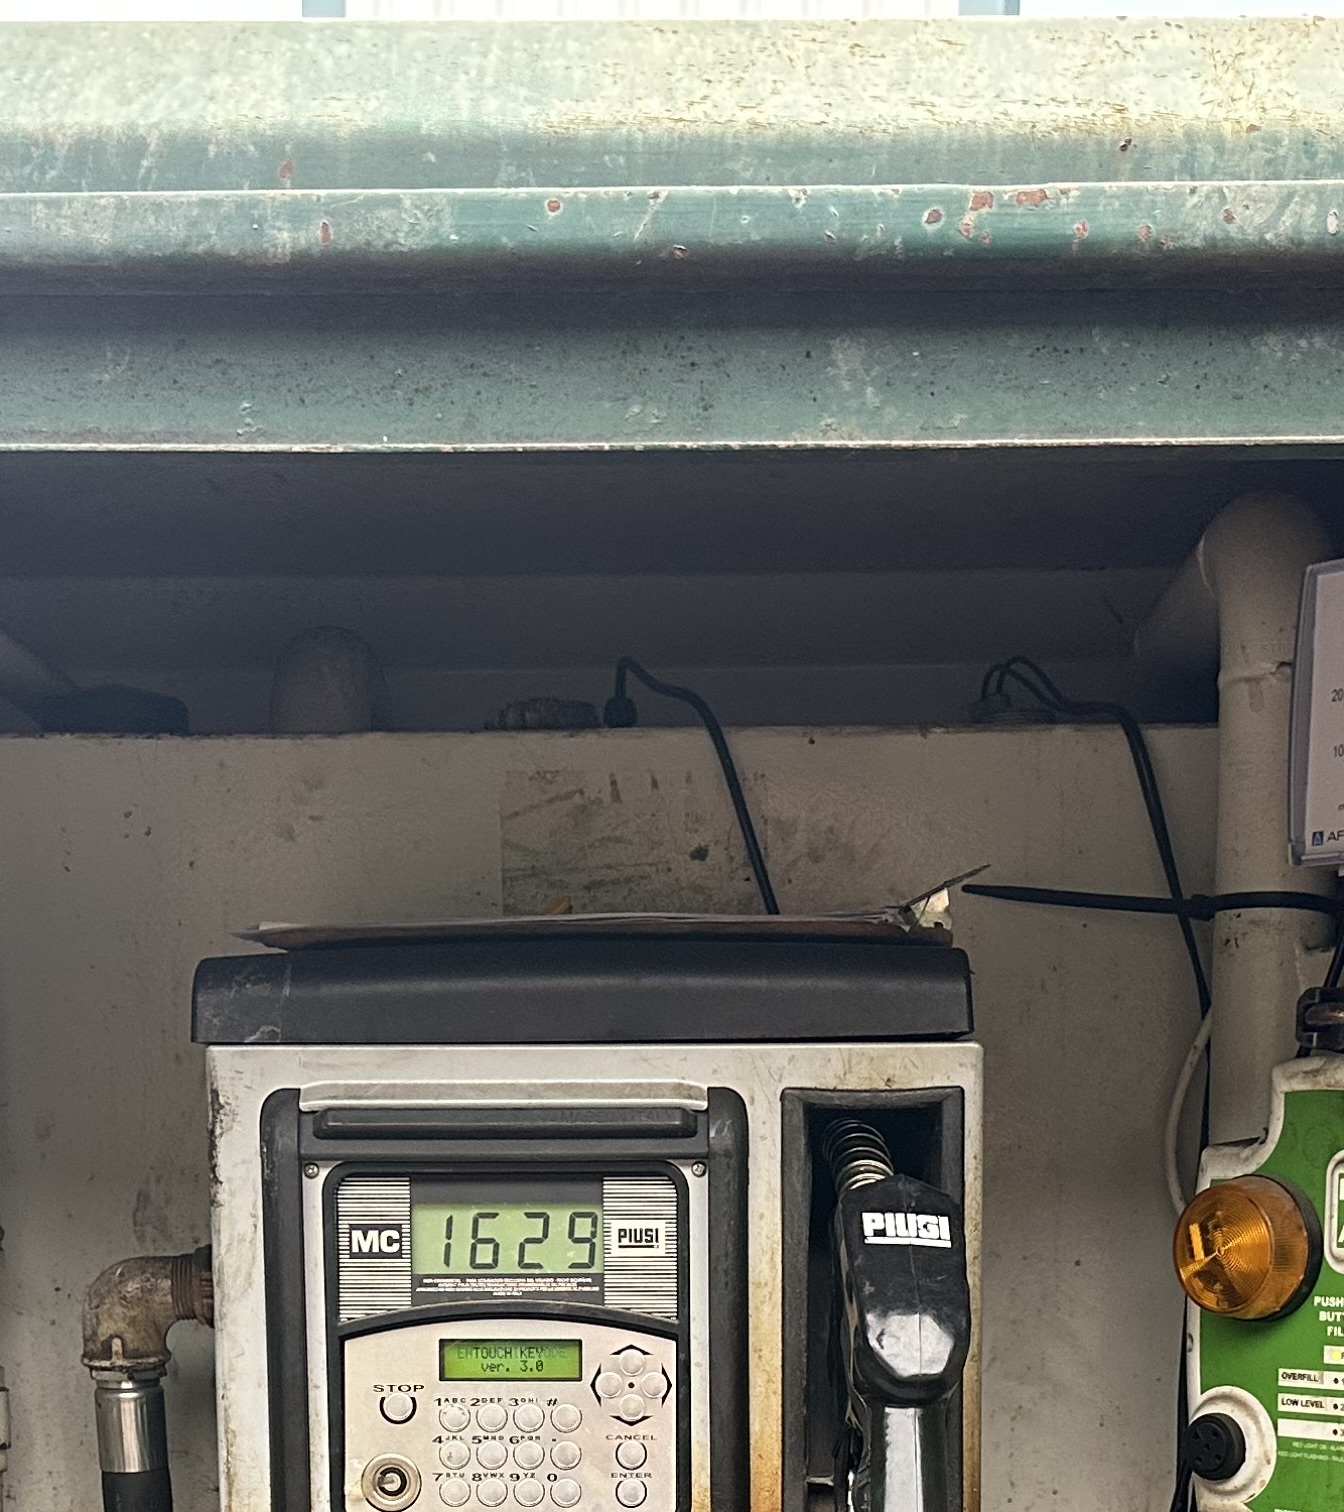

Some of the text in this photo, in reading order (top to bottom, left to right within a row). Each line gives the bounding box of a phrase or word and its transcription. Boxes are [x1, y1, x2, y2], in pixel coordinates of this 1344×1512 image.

[1331, 688, 1344, 702] 20
[1334, 744, 1344, 758] 10
[351, 1229, 401, 1254] MC
[443, 1211, 598, 1270] 1629
[618, 1228, 659, 1243] PIUSI
[1313, 1296, 1344, 1308] PUSH
[520, 1360, 544, 1373] 3.0
[1281, 1371, 1319, 1383] OVERFILL
[373, 1384, 425, 1393] STOP
[1281, 1397, 1299, 1406] LOW
[1300, 1399, 1325, 1409] LEVEL
